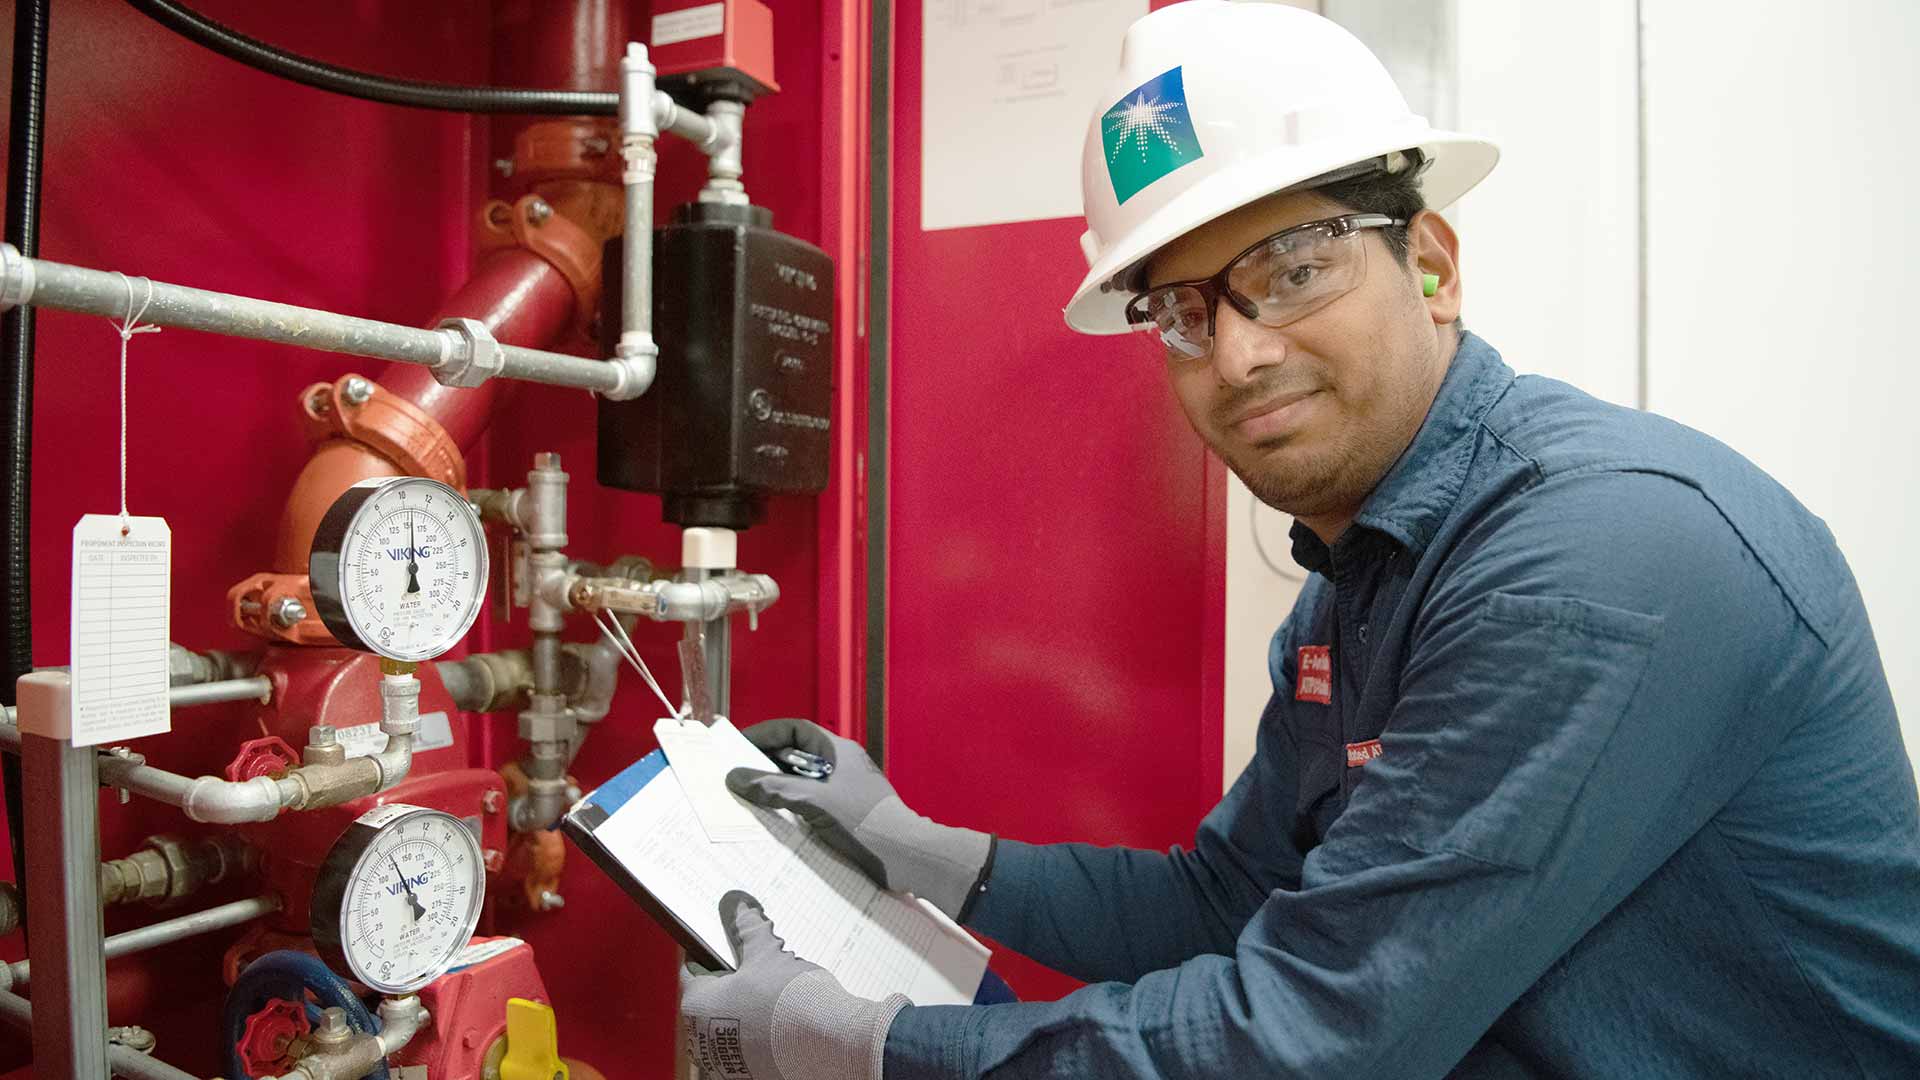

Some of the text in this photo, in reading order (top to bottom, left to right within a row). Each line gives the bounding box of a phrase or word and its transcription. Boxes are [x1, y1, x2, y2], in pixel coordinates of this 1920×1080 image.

[398, 490, 406, 499] 10
[425, 494, 433, 503] 12
[389, 526, 400, 534] 125
[417, 525, 427, 533] 175
[379, 537, 390, 545] 100
[426, 534, 437, 542] 200
[374, 551, 382, 559] 75
[386, 545, 431, 561] VIKING
[432, 547, 444, 555] 225
[370, 568, 379, 576] 50
[433, 578, 444, 586] 275
[429, 589, 440, 598] 300
[400, 600, 421, 609] WATER
[423, 822, 430, 831] 12
[402, 853, 412, 862] 150
[386, 871, 428, 896] VIKING
[371, 908, 379, 917] 50
[428, 912, 438, 921] 300
[375, 922, 383, 931] 25
[399, 927, 420, 940] WATER
[698, 1032, 715, 1072] ALLFLEX
[715, 1027, 737, 1074] JOGGER
[726, 1027, 747, 1074] SAFETY
